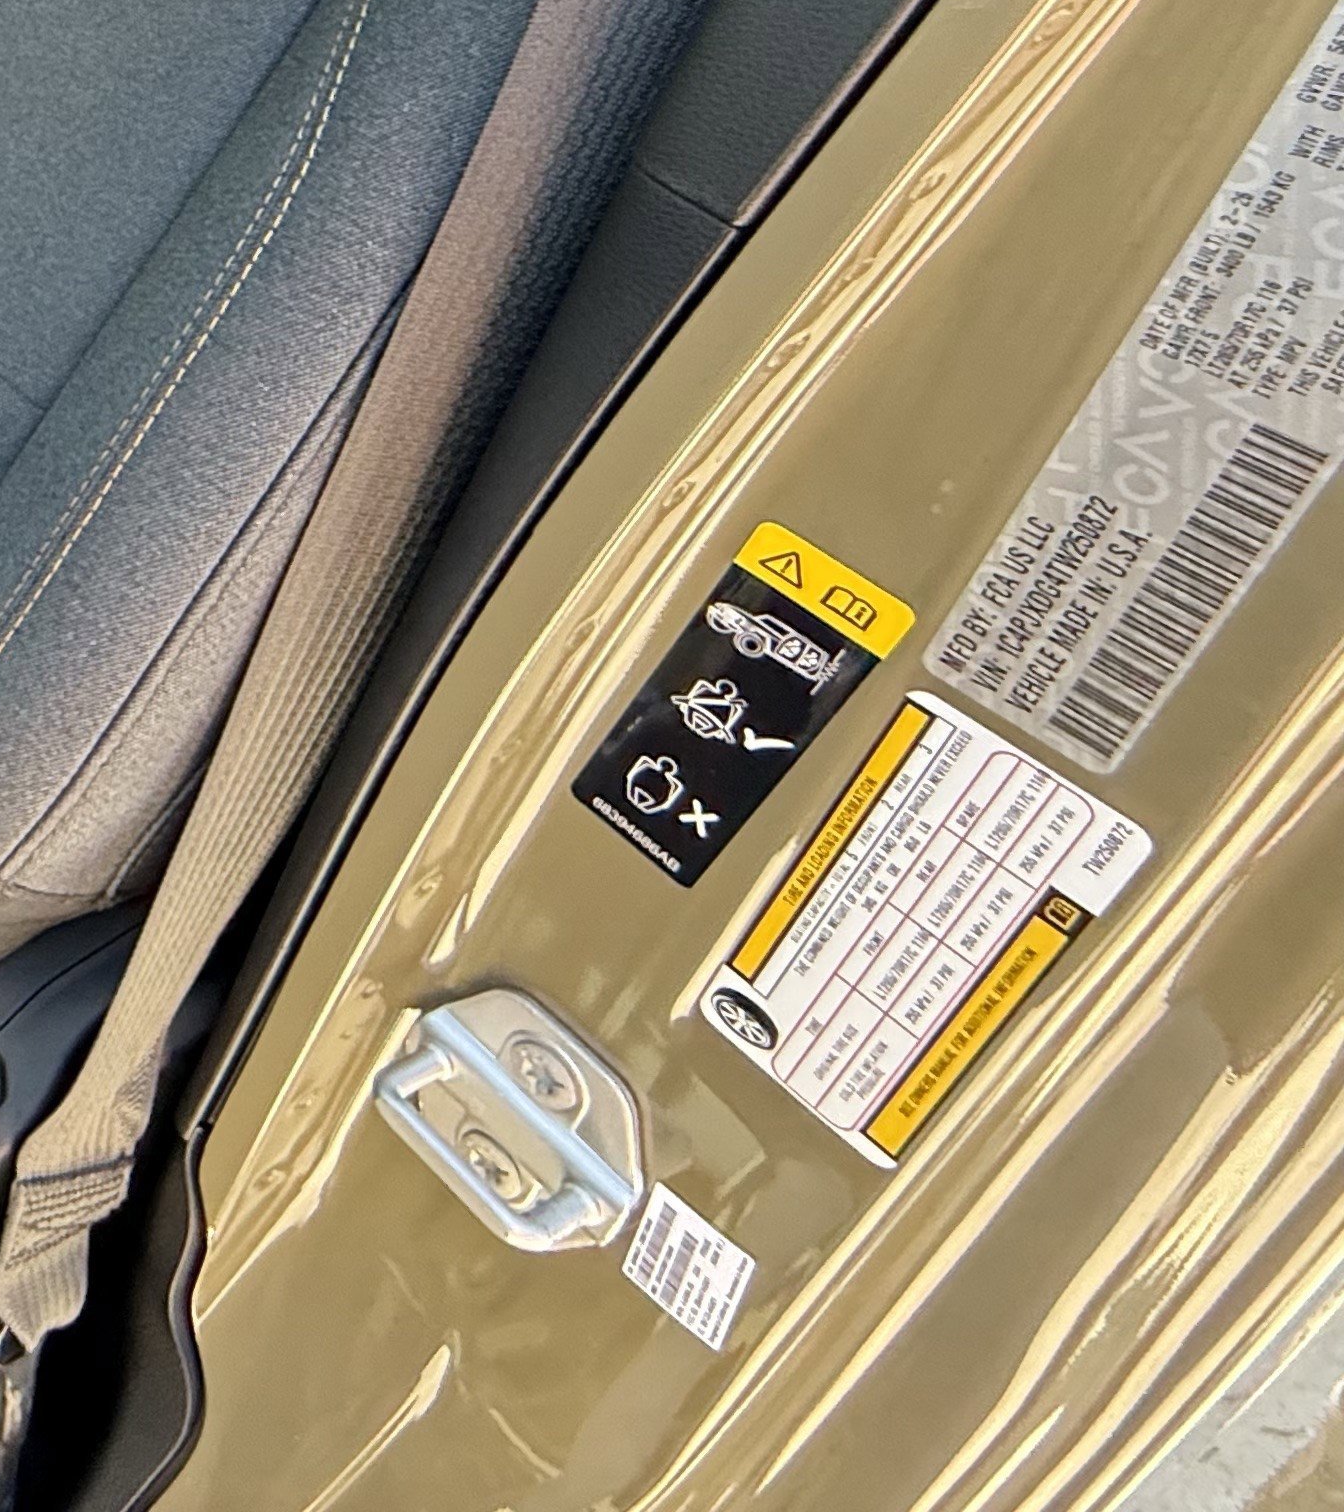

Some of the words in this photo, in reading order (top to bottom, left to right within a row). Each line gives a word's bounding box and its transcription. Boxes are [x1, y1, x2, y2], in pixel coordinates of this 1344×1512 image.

[1270, 171, 1295, 189] KG
[1288, 125, 1326, 158] WITH
[1286, 276, 1314, 298] PSI
[1275, 300, 1299, 315] 37
[1274, 337, 1306, 364] MPV
[1227, 372, 1250, 386] AT
[1287, 368, 1320, 397] THIS
[1017, 515, 1054, 549] LLC
[1096, 520, 1152, 578] U.S.A.
[1001, 546, 1035, 574] US
[971, 656, 1010, 692] VIN:
[992, 495, 1117, 657] 1C4PJXDG4TW250872
[981, 570, 1019, 605] FCA
[1079, 574, 1116, 604] IN:
[963, 605, 996, 634] BY:
[1048, 600, 1097, 650] MADE
[939, 633, 977, 669] MFD
[1006, 647, 1066, 714] VEHICLE
[880, 836, 897, 854] AND
[928, 758, 952, 785] NEVER
[945, 730, 972, 761] EXCEED
[782, 884, 803, 905] TIRE
[795, 866, 815, 887] AND
[807, 831, 839, 869] LOADING
[831, 775, 877, 834] INFORMATION
[1081, 818, 1133, 879] TW250872
